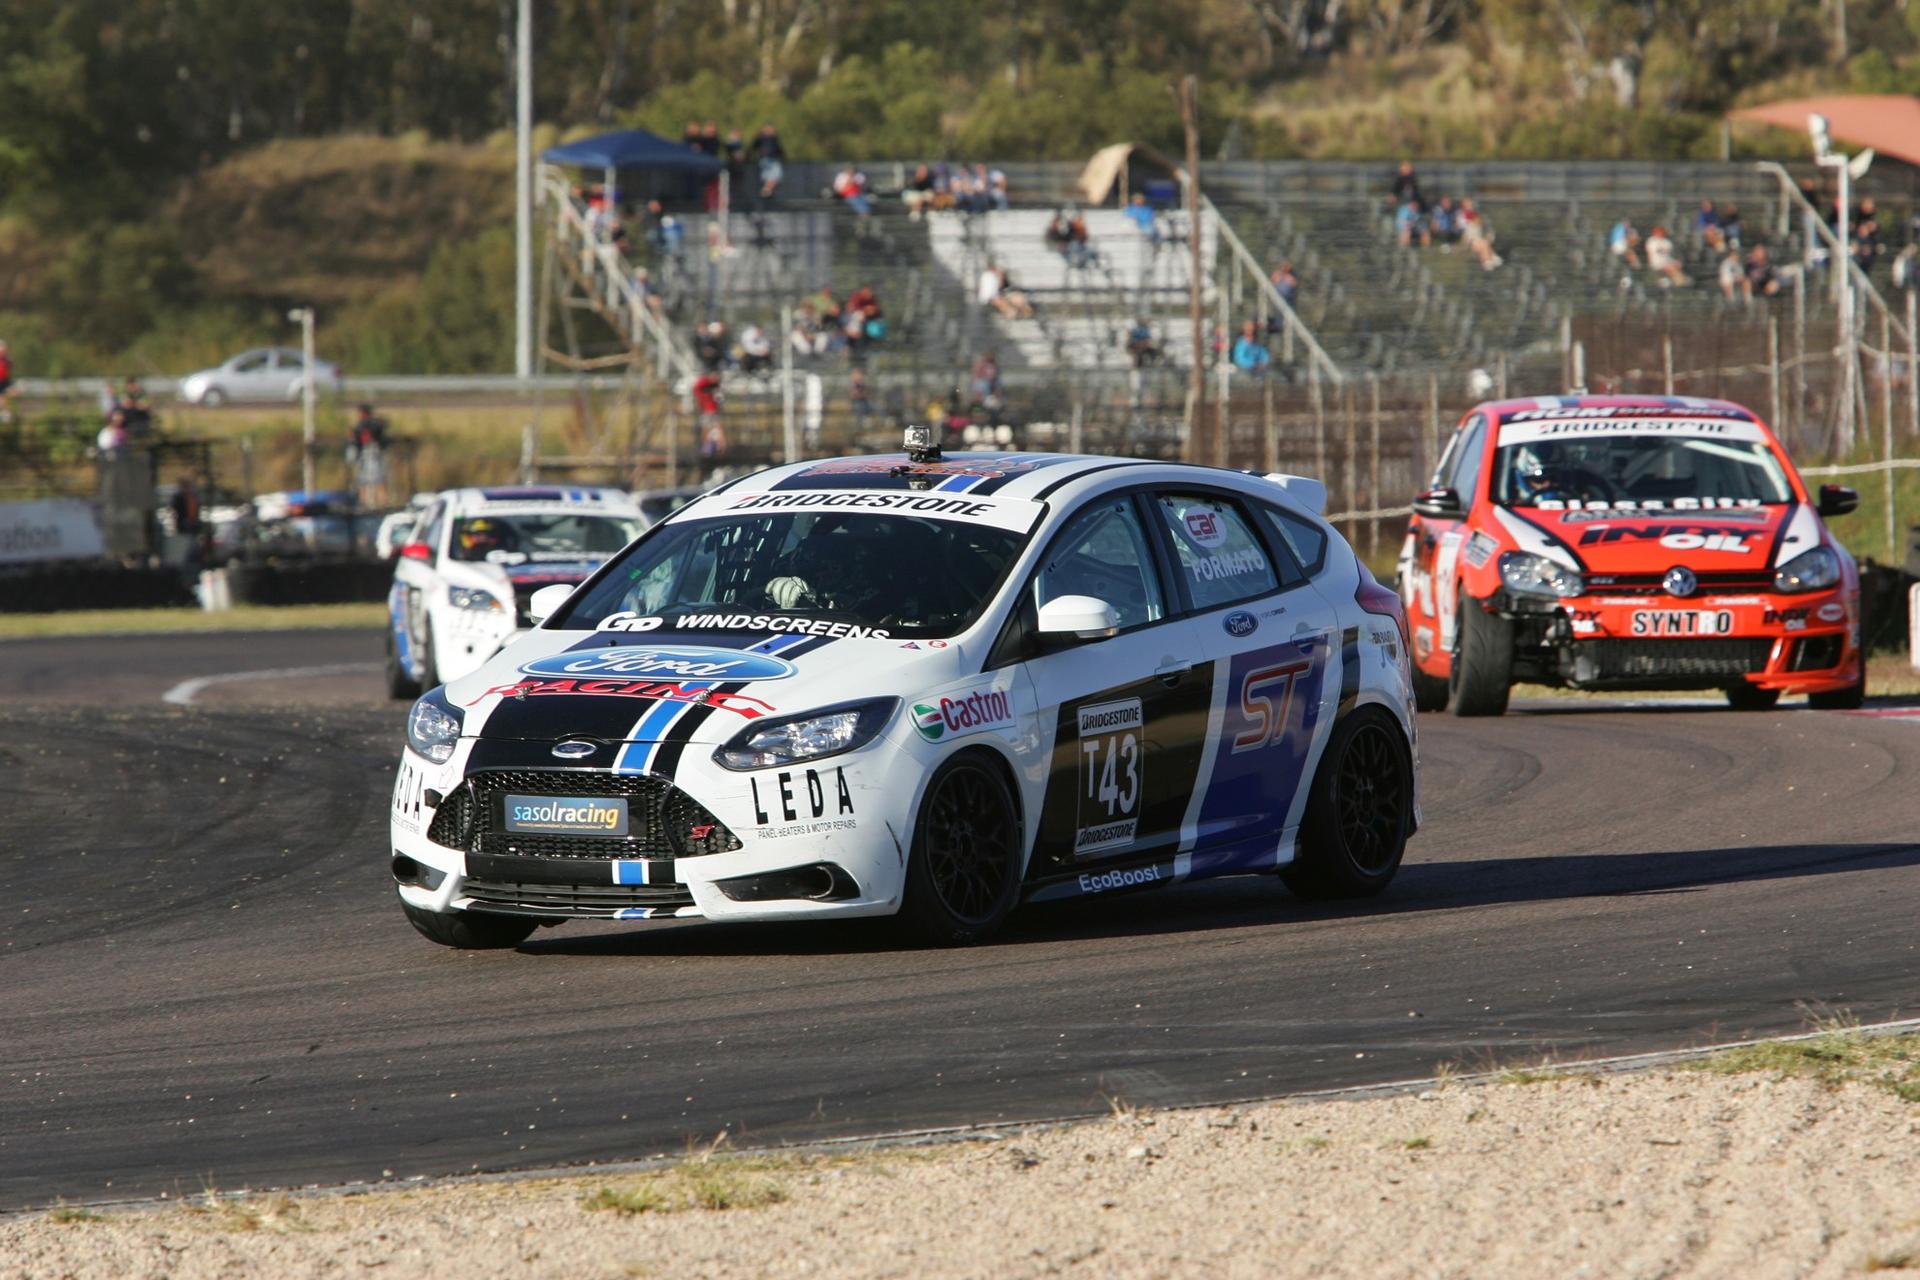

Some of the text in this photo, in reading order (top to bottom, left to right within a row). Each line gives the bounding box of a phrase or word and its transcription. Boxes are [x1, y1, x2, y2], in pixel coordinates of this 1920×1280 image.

[1539, 420, 1732, 435] BRIDGESTONE
[729, 493, 998, 517] BRIDGESTONE
[1186, 513, 1217, 536] car
[1659, 533, 1751, 553] OIL
[675, 614, 890, 640] WINDSCREENS
[1229, 615, 1253, 634] Ford
[1632, 610, 1733, 635] SYNTRO
[564, 649, 748, 676] Ford
[468, 679, 776, 719] RACING
[940, 686, 1011, 731] Castrol
[1231, 656, 1314, 755] ST
[1081, 706, 1140, 731] BRIDGESTONE
[1083, 733, 1139, 816] T43
[750, 766, 854, 824] LEDA
[513, 801, 619, 829] sasolracing
[1078, 822, 1136, 847] BRIDGESTONE
[1078, 863, 1161, 892] EcoBoost
